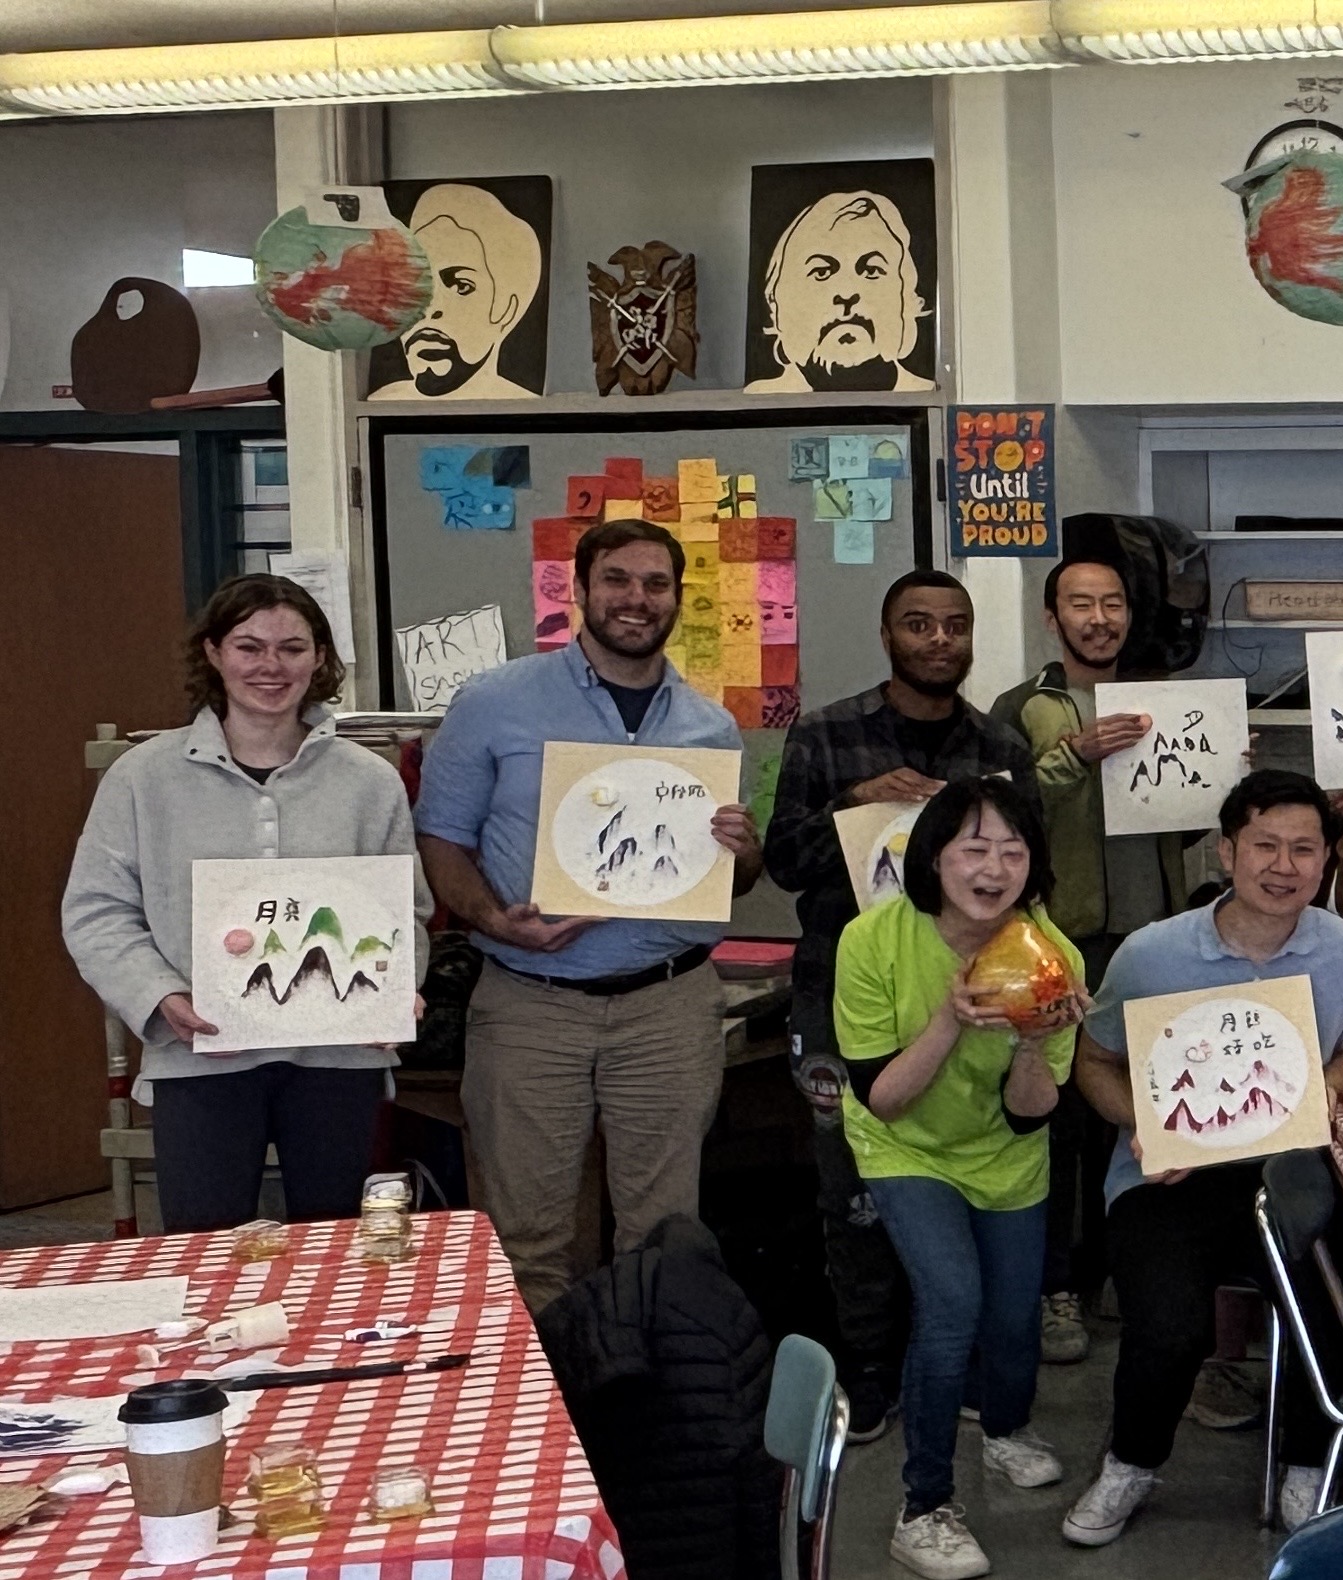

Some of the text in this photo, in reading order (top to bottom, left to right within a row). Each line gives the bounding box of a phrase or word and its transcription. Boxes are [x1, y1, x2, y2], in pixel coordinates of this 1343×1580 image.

[954, 440, 1046, 472] STOP
[970, 471, 1030, 499] Until
[962, 522, 1048, 547] PROUD
[415, 611, 482, 665] ART
